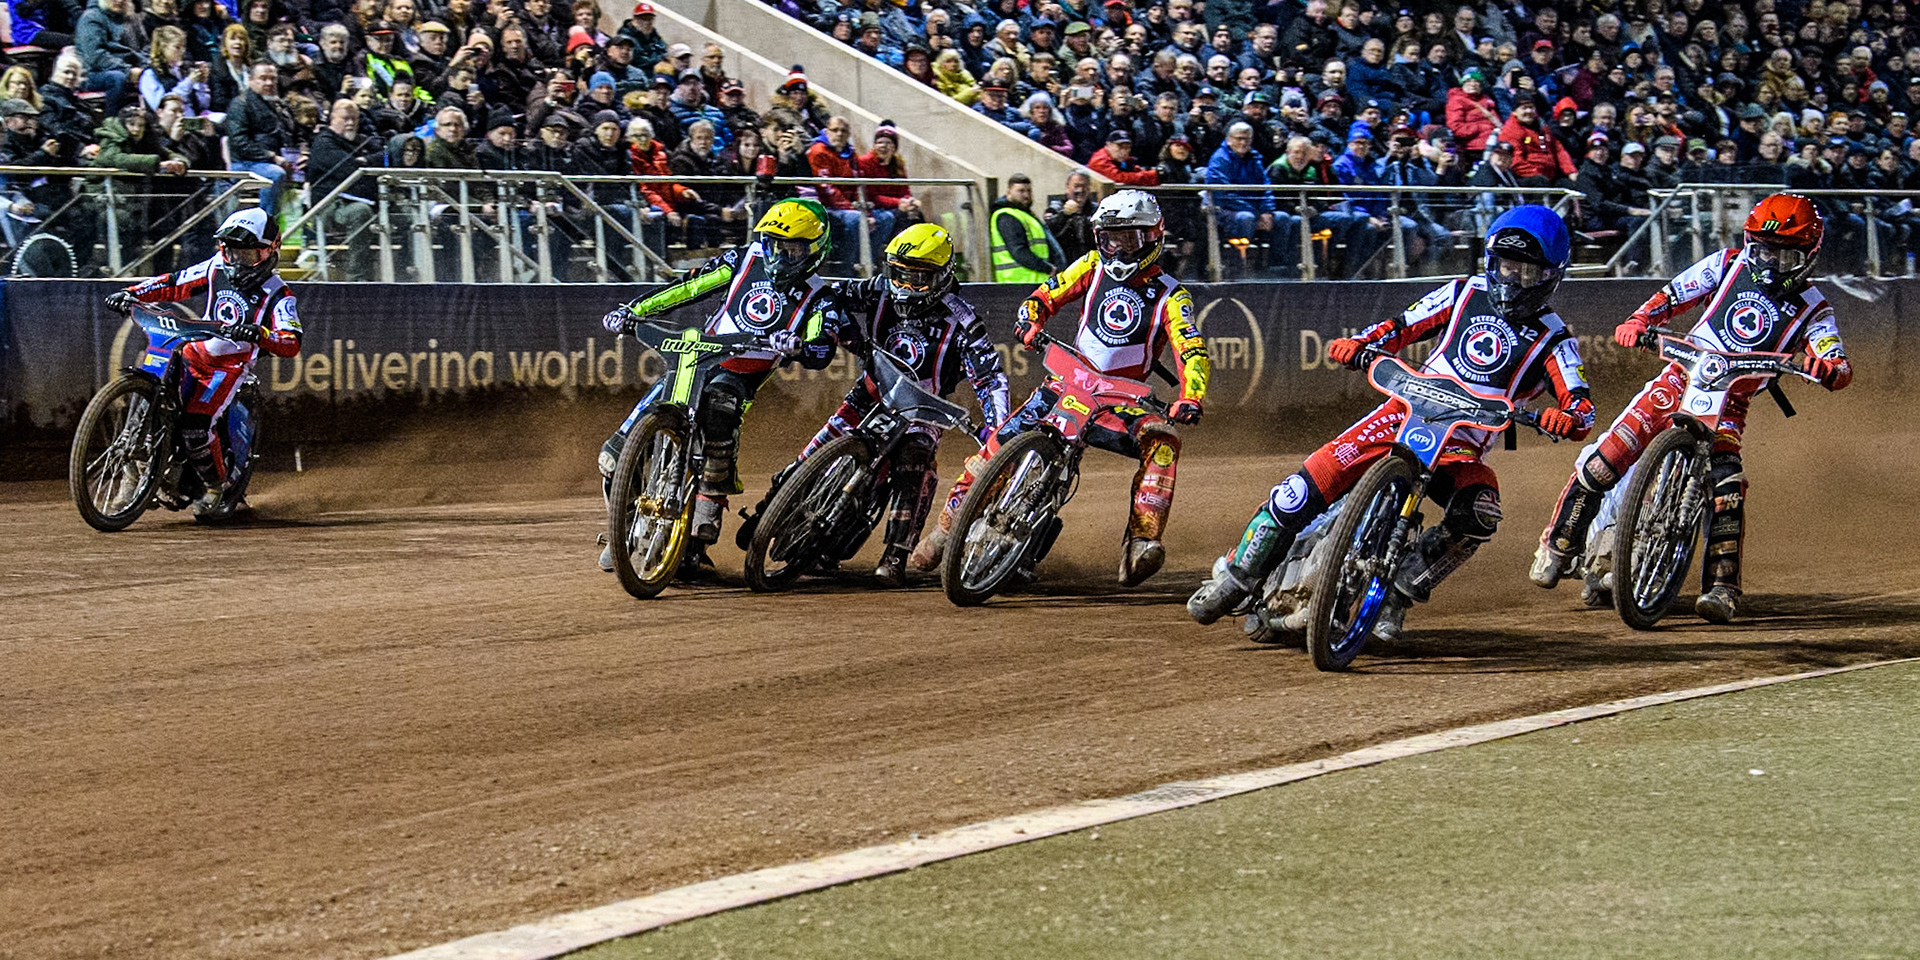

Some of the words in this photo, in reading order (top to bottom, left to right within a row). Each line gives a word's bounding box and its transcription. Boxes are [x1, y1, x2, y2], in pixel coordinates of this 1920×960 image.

[249, 294, 260, 305] 3
[788, 286, 804, 301] 14
[1736, 290, 1761, 300] PETER
[1759, 294, 1780, 323] CRAVEN
[1780, 300, 1798, 318] 15
[929, 325, 943, 339] 11
[1467, 324, 1488, 336] BELLE
[1490, 326, 1503, 337] VUE
[1469, 314, 1498, 324] PETER
[1496, 317, 1519, 347] CRAVEN
[1518, 324, 1539, 343] 12
[1207, 336, 1250, 371] ATPI
[271, 338, 495, 393] Delivering
[508, 337, 625, 388] world
[1451, 356, 1491, 383] MEMORIAL
[1356, 411, 1406, 442] EASTERN
[1409, 432, 1431, 446] ATPI
